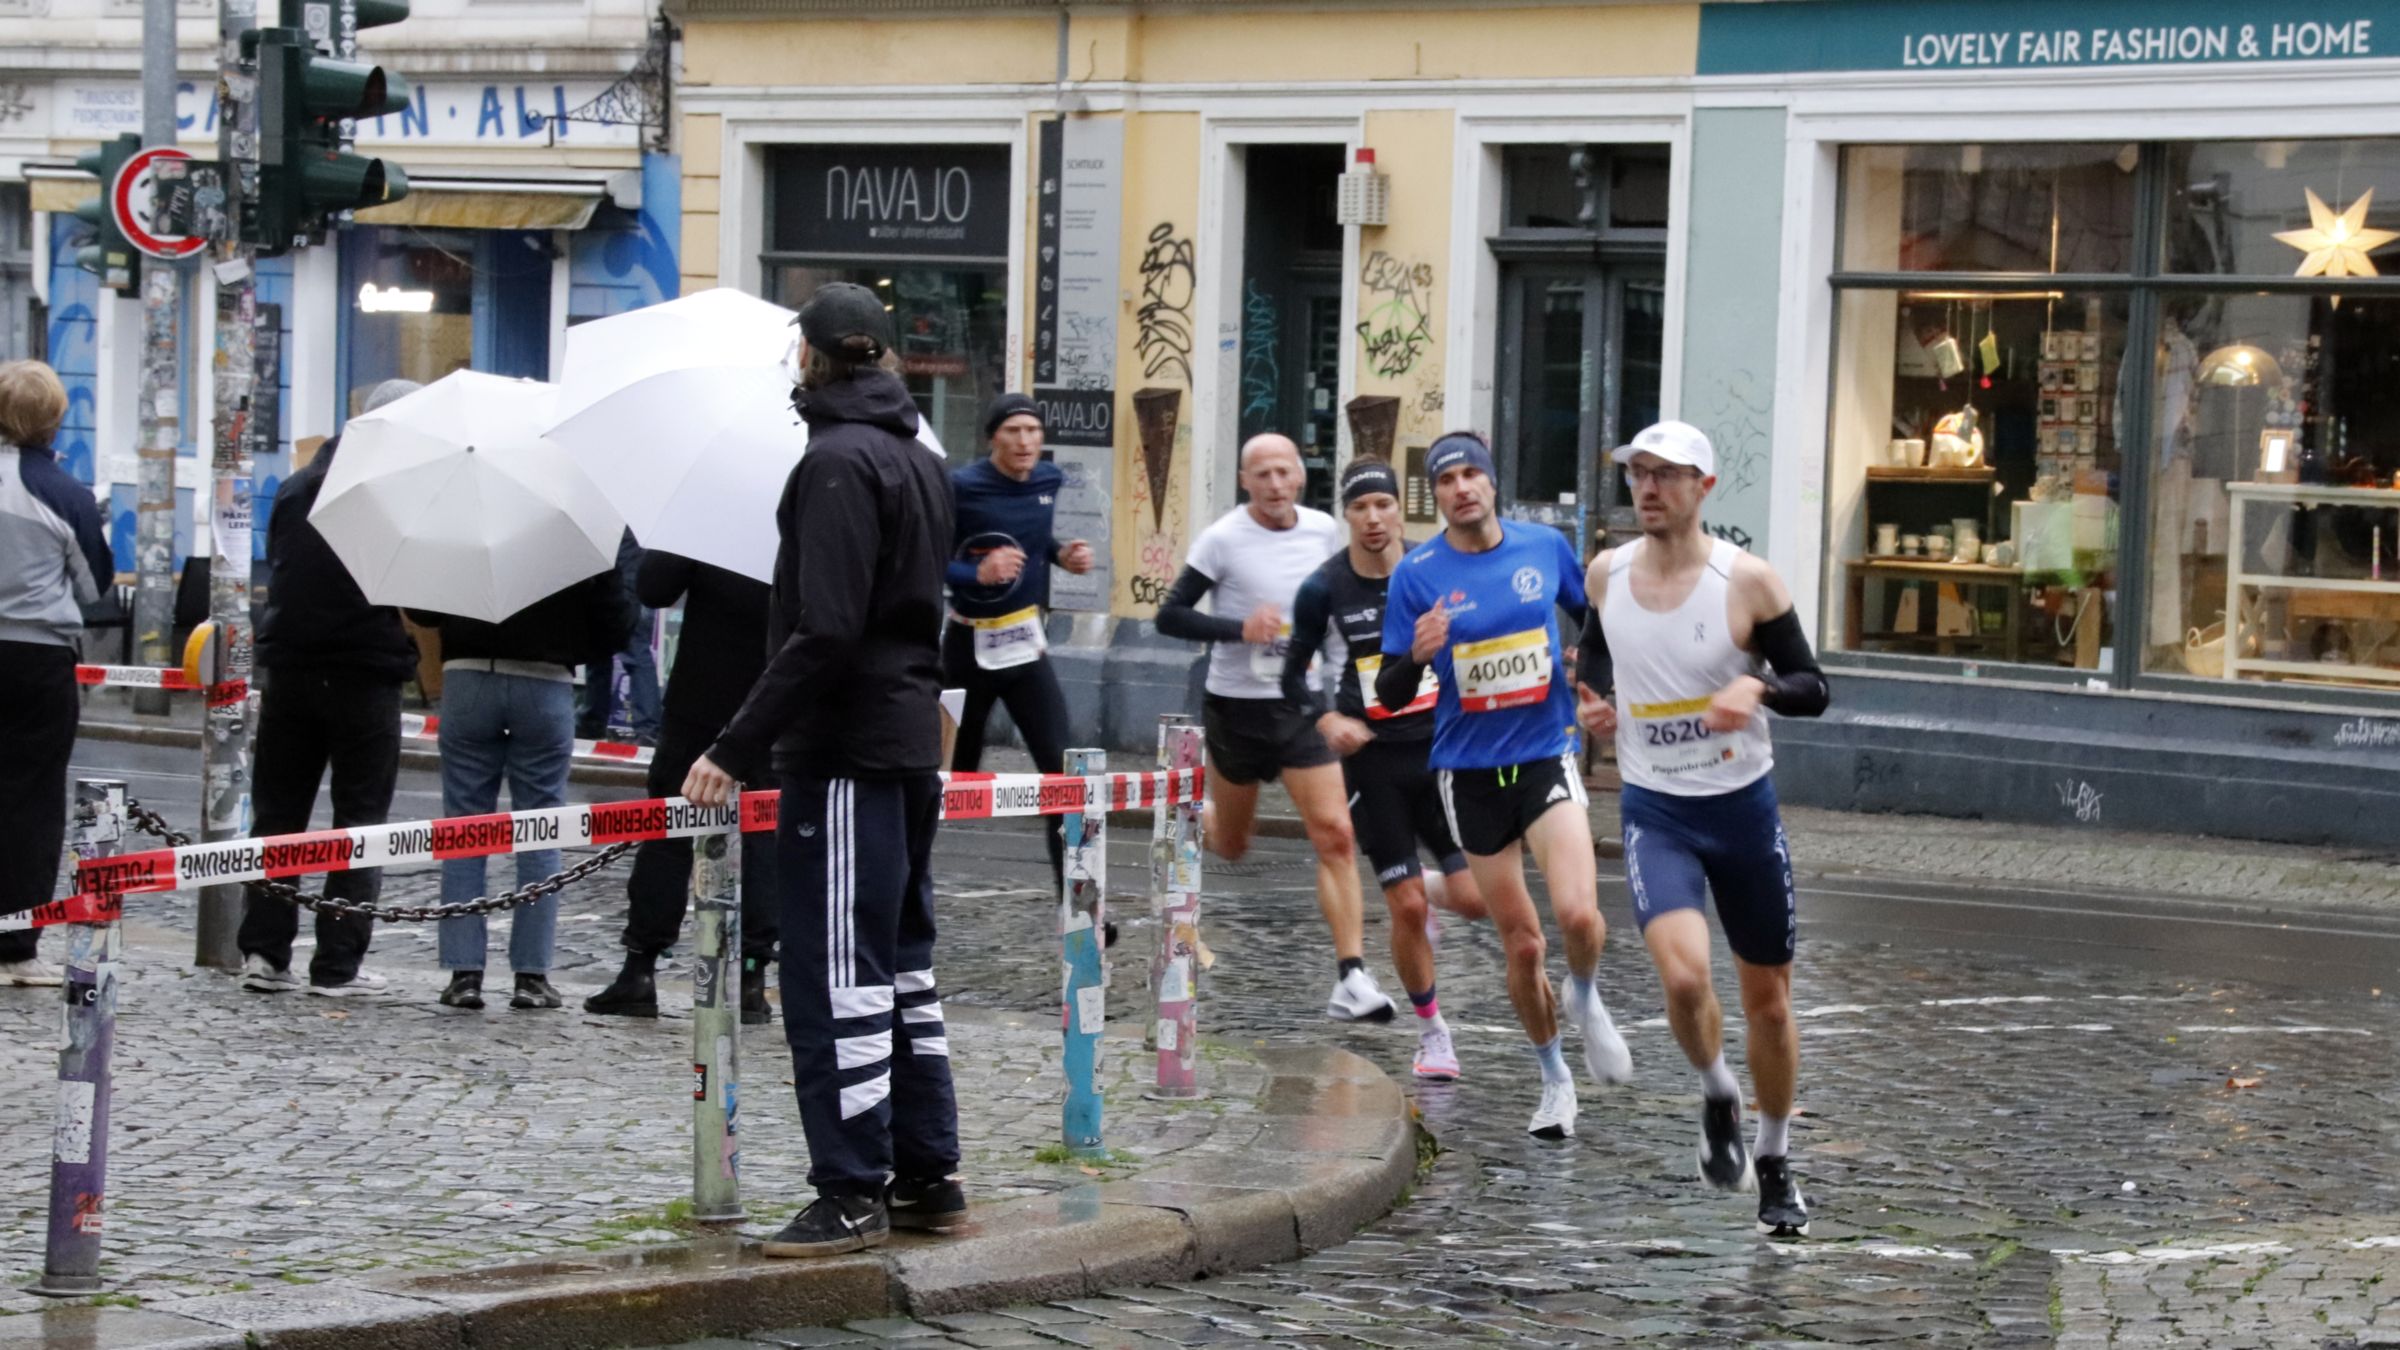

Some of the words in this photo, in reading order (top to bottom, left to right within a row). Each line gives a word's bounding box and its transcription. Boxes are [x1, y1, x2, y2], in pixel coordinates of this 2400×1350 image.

[1903, 32, 2010, 66] LOVELY
[2018, 30, 2081, 63] FAIR
[2091, 25, 2228, 62] FASHION
[2238, 24, 2261, 57] &
[2270, 20, 2373, 56] HOME
[826, 166, 971, 222] NAVAJO
[1468, 652, 1539, 682] 40001
[1645, 716, 1713, 746] 2620
[996, 782, 1094, 810] POLIZEIABSPERRUNG
[180, 834, 366, 881] POLIZEIABSPERRUNG
[388, 814, 560, 857] POLIZEIABSPERRUNG
